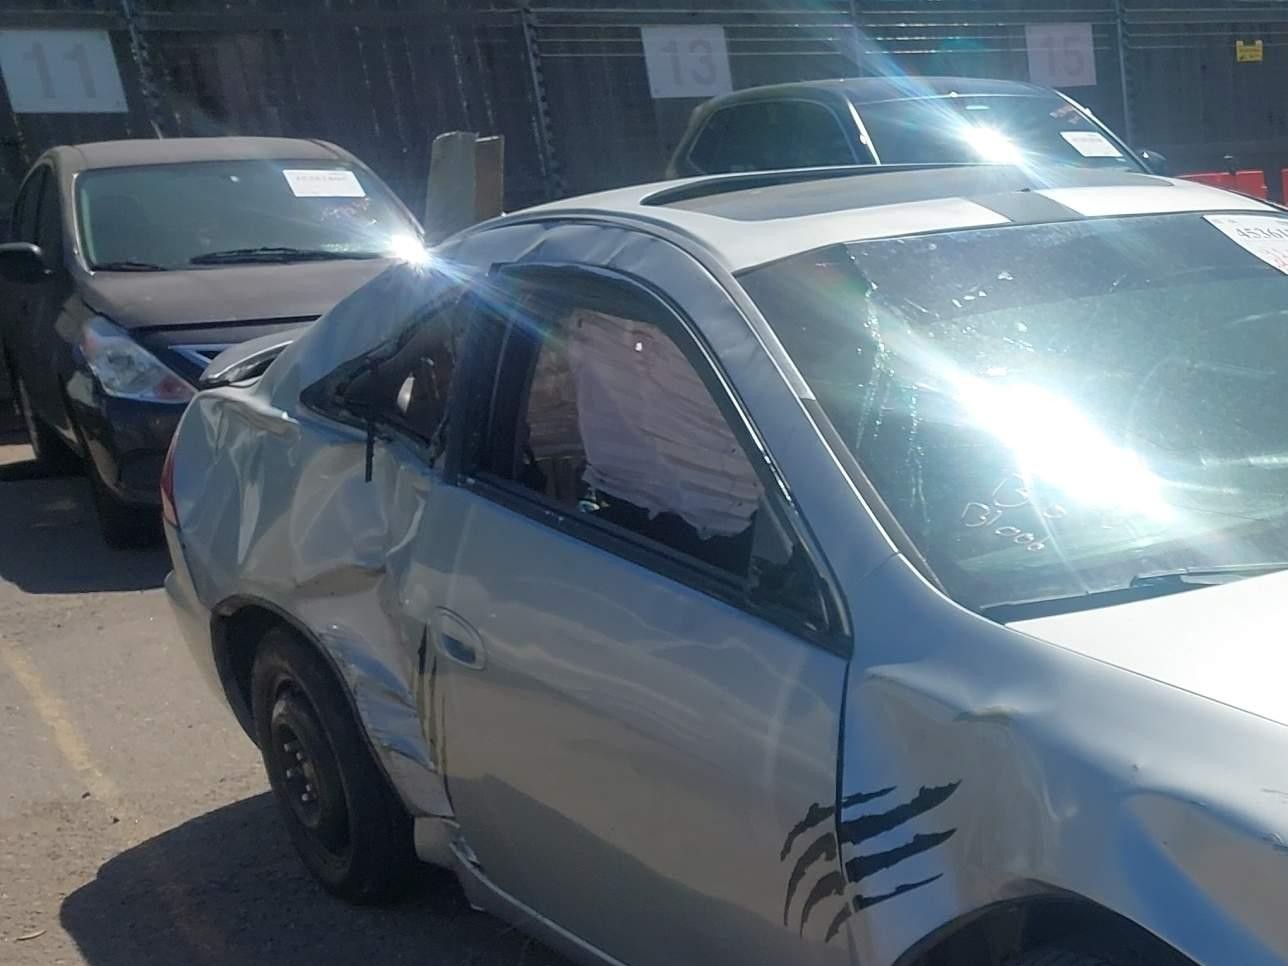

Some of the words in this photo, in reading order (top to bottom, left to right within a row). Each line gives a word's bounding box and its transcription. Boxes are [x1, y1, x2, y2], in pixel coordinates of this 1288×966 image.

[22, 42, 97, 99] 11
[660, 38, 717, 87] 13
[1040, 34, 1085, 78] 15
